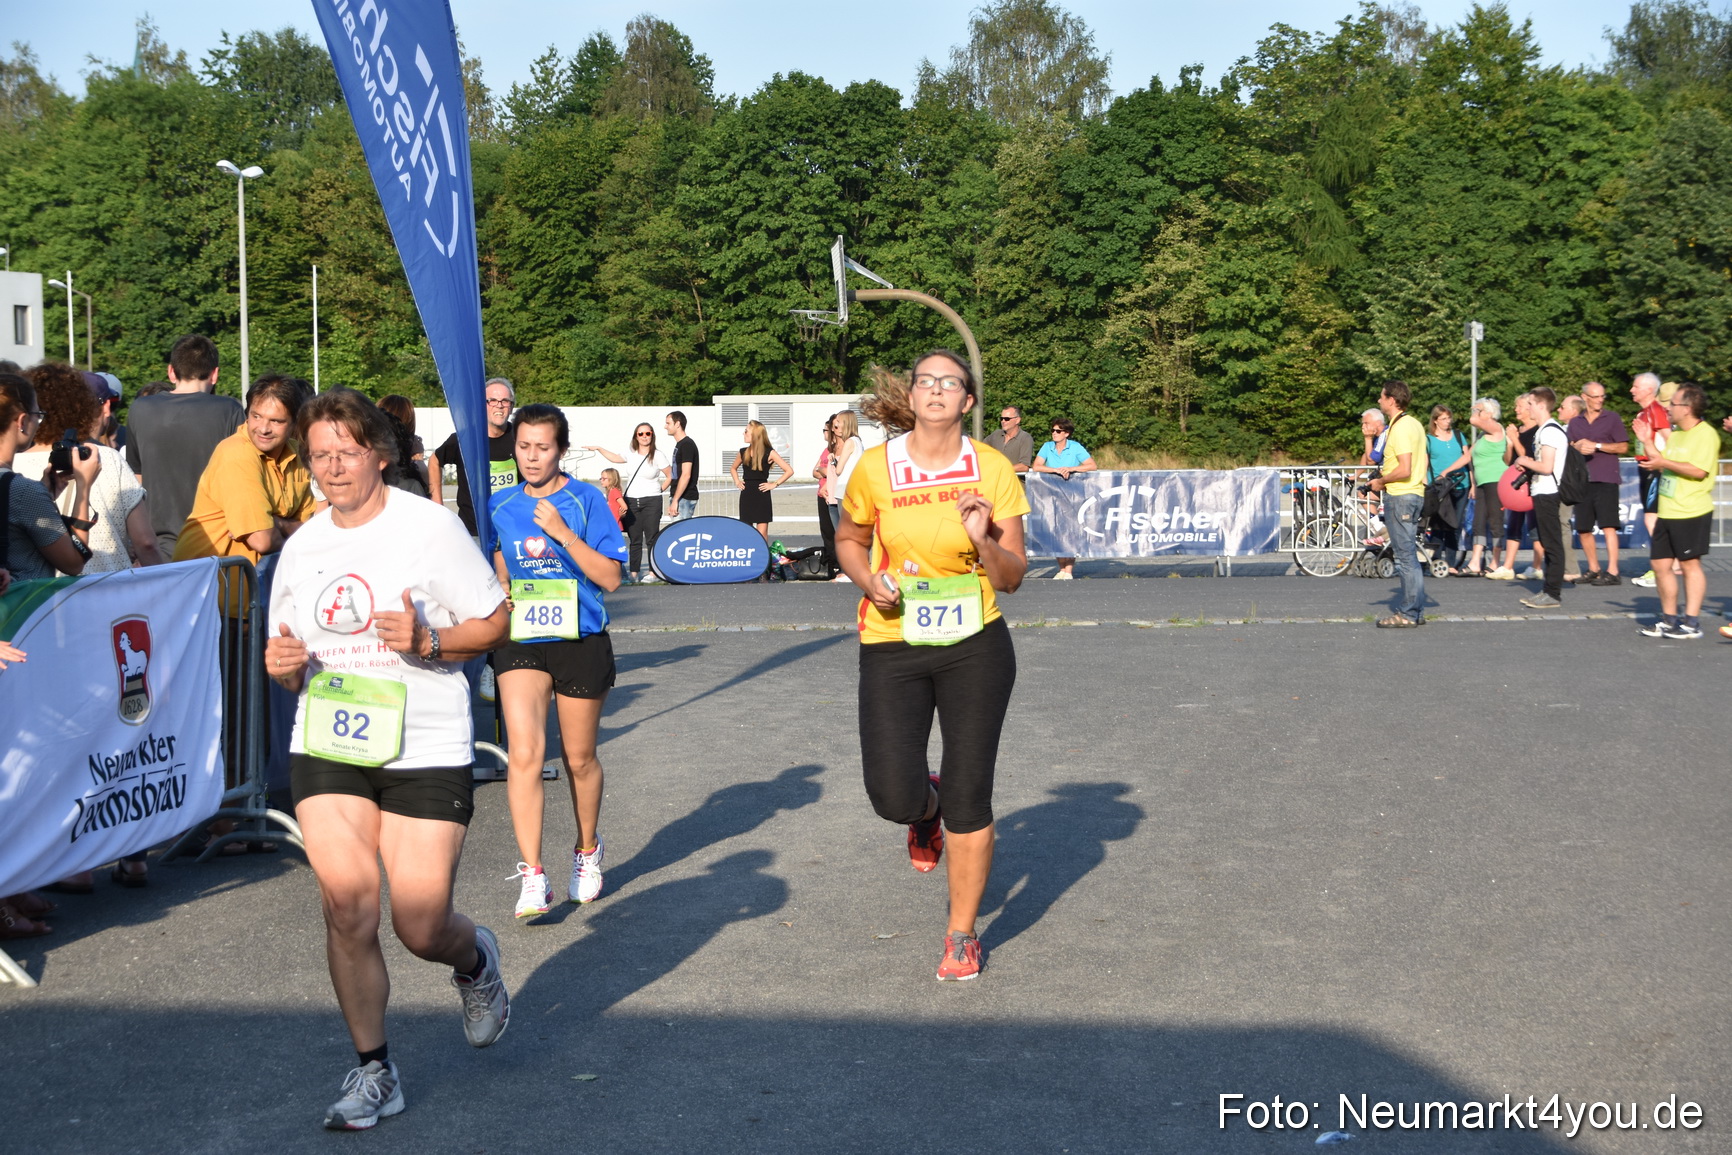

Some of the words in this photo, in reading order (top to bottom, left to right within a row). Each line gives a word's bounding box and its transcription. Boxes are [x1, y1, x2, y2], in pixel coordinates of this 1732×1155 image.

[490, 473, 514, 486] 239
[892, 493, 932, 508] MAX
[1104, 506, 1229, 530] Fischer
[1116, 532, 1217, 543] AUTOMOBILE
[513, 540, 524, 559] I
[684, 545, 756, 561] Fischer
[519, 557, 562, 568] camping
[692, 560, 752, 568] AUTOMOBILE
[524, 605, 563, 626] 488
[917, 604, 962, 627] 871
[312, 647, 346, 659] AUFEN
[351, 644, 372, 654] MIT
[369, 658, 400, 668] Röschl
[124, 698, 143, 715] 1628
[333, 709, 370, 741] 82
